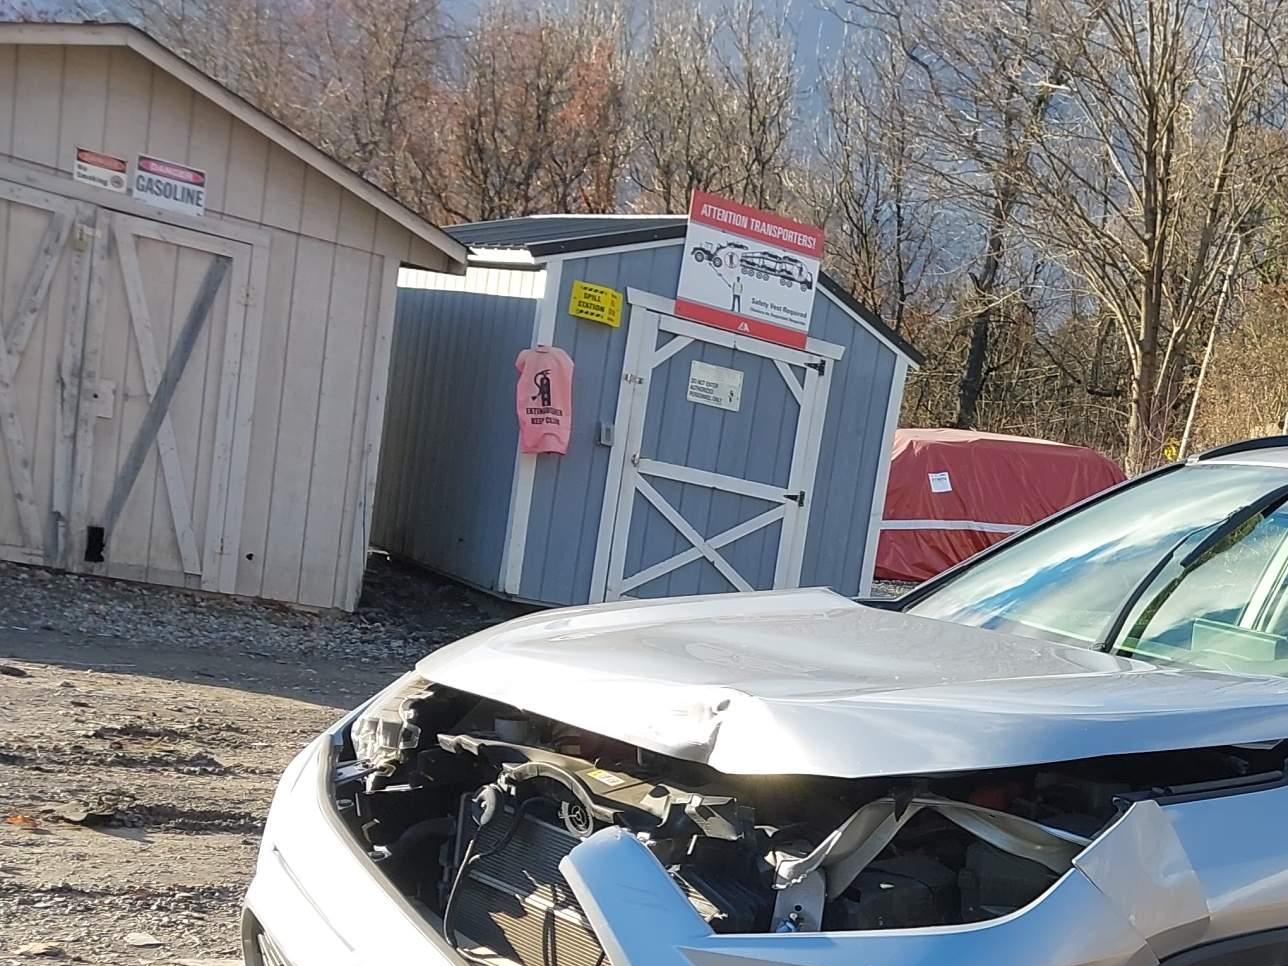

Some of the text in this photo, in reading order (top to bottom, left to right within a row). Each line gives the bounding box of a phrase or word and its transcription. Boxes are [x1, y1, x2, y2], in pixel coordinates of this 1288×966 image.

[135, 174, 205, 207] GASOLINE
[701, 204, 816, 249] ATTENTION TRANSPORTERS!
[583, 292, 602, 303] SPILL
[751, 297, 769, 310] Safety
[577, 300, 606, 313] STATION
